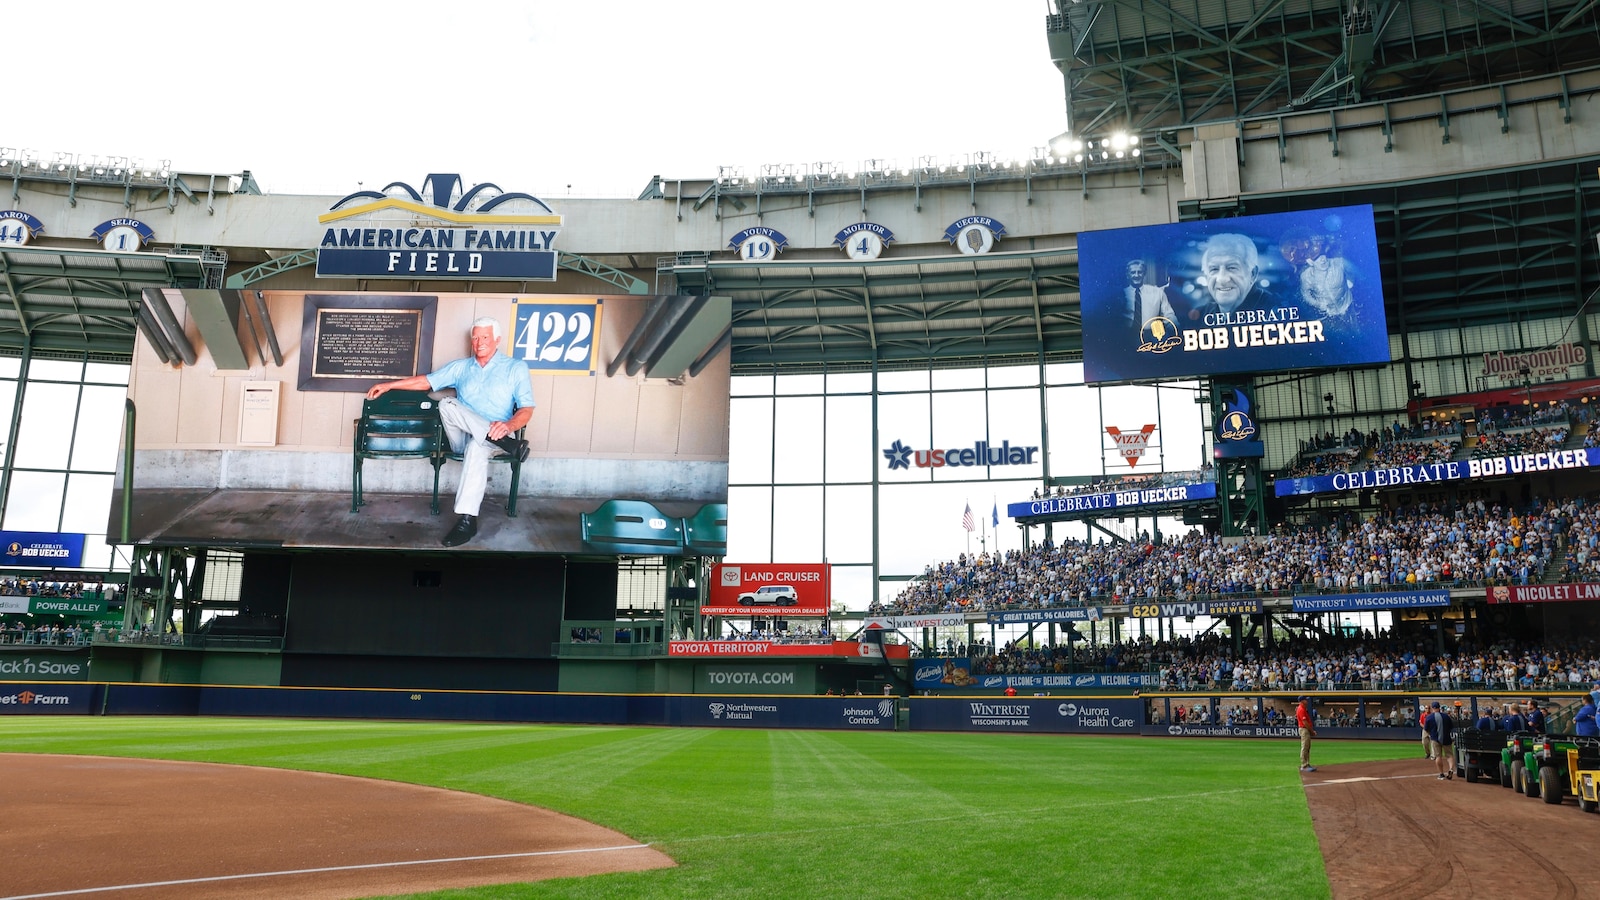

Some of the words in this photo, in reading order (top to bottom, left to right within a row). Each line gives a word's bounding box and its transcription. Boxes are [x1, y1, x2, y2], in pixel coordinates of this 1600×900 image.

[110, 219, 139, 228] SELIG
[955, 217, 992, 229] UECKER
[743, 227, 775, 238] YOUNT
[843, 224, 885, 236] MOLITOR
[118, 234, 127, 250] 1
[321, 228, 453, 248] AMERICAN
[464, 230, 556, 249] FAMILY
[745, 241, 771, 259] 19
[856, 238, 869, 255] 4
[388, 252, 483, 272] FIELD
[1204, 306, 1299, 326] CELEBRATE
[515, 311, 591, 363] 422
[1182, 327, 1229, 351] BOB
[1232, 320, 1325, 348] UECKER
[1482, 343, 1585, 375] Johnsonville
[1500, 371, 1534, 380] PARY
[1539, 366, 1568, 376] DECK
[1113, 434, 1149, 444] VIZZY
[1121, 448, 1144, 456] LOFT
[1332, 462, 1461, 490] CELEBRATE
[1469, 456, 1507, 478] BOB
[1510, 449, 1589, 475] UECKER
[1031, 494, 1111, 514] CELEBRATE
[1116, 490, 1140, 506] BOB
[1141, 486, 1188, 503] UECKER
[22, 548, 38, 556] BOB
[39, 549, 69, 557] UECKER
[744, 571, 774, 582] LAND
[776, 571, 821, 582] CRUISER
[1516, 586, 1569, 601] NICOLET
[36, 602, 70, 610] POWER
[71, 603, 100, 611] ALLEY
[1294, 598, 1346, 609] WINTRUST
[1355, 595, 1417, 606] WISCONSIN'S
[1419, 594, 1446, 604] BANK
[1003, 613, 1023, 621] GREAT
[1023, 612, 1044, 621] TASTE.
[1044, 611, 1054, 620] 96
[1053, 610, 1087, 619] CALORIES.
[1132, 604, 1159, 618] 620
[1161, 602, 1207, 617] WTMJ
[1210, 606, 1257, 614] BREWERS
[671, 643, 712, 653] TOYOTA
[713, 643, 769, 653] TERRITORY
[38, 661, 80, 674] Save
[708, 672, 794, 685] TOYOTA.COM
[1006, 676, 1034, 687] WELCOME
[1043, 676, 1072, 686] DELICIOUS
[1101, 675, 1131, 686] WELCOME
[34, 694, 69, 704] Farm
[726, 703, 777, 712] Northwestern
[843, 707, 874, 716] Johnson
[970, 702, 1030, 715] WINTRUST
[1078, 706, 1109, 716] Aurora
[726, 712, 753, 720] Mutual
[848, 716, 880, 725] Controls
[1078, 717, 1110, 727] Health
[1111, 717, 1134, 727] Care
[1184, 727, 1206, 735] Aurora
[1208, 727, 1232, 735] Health
